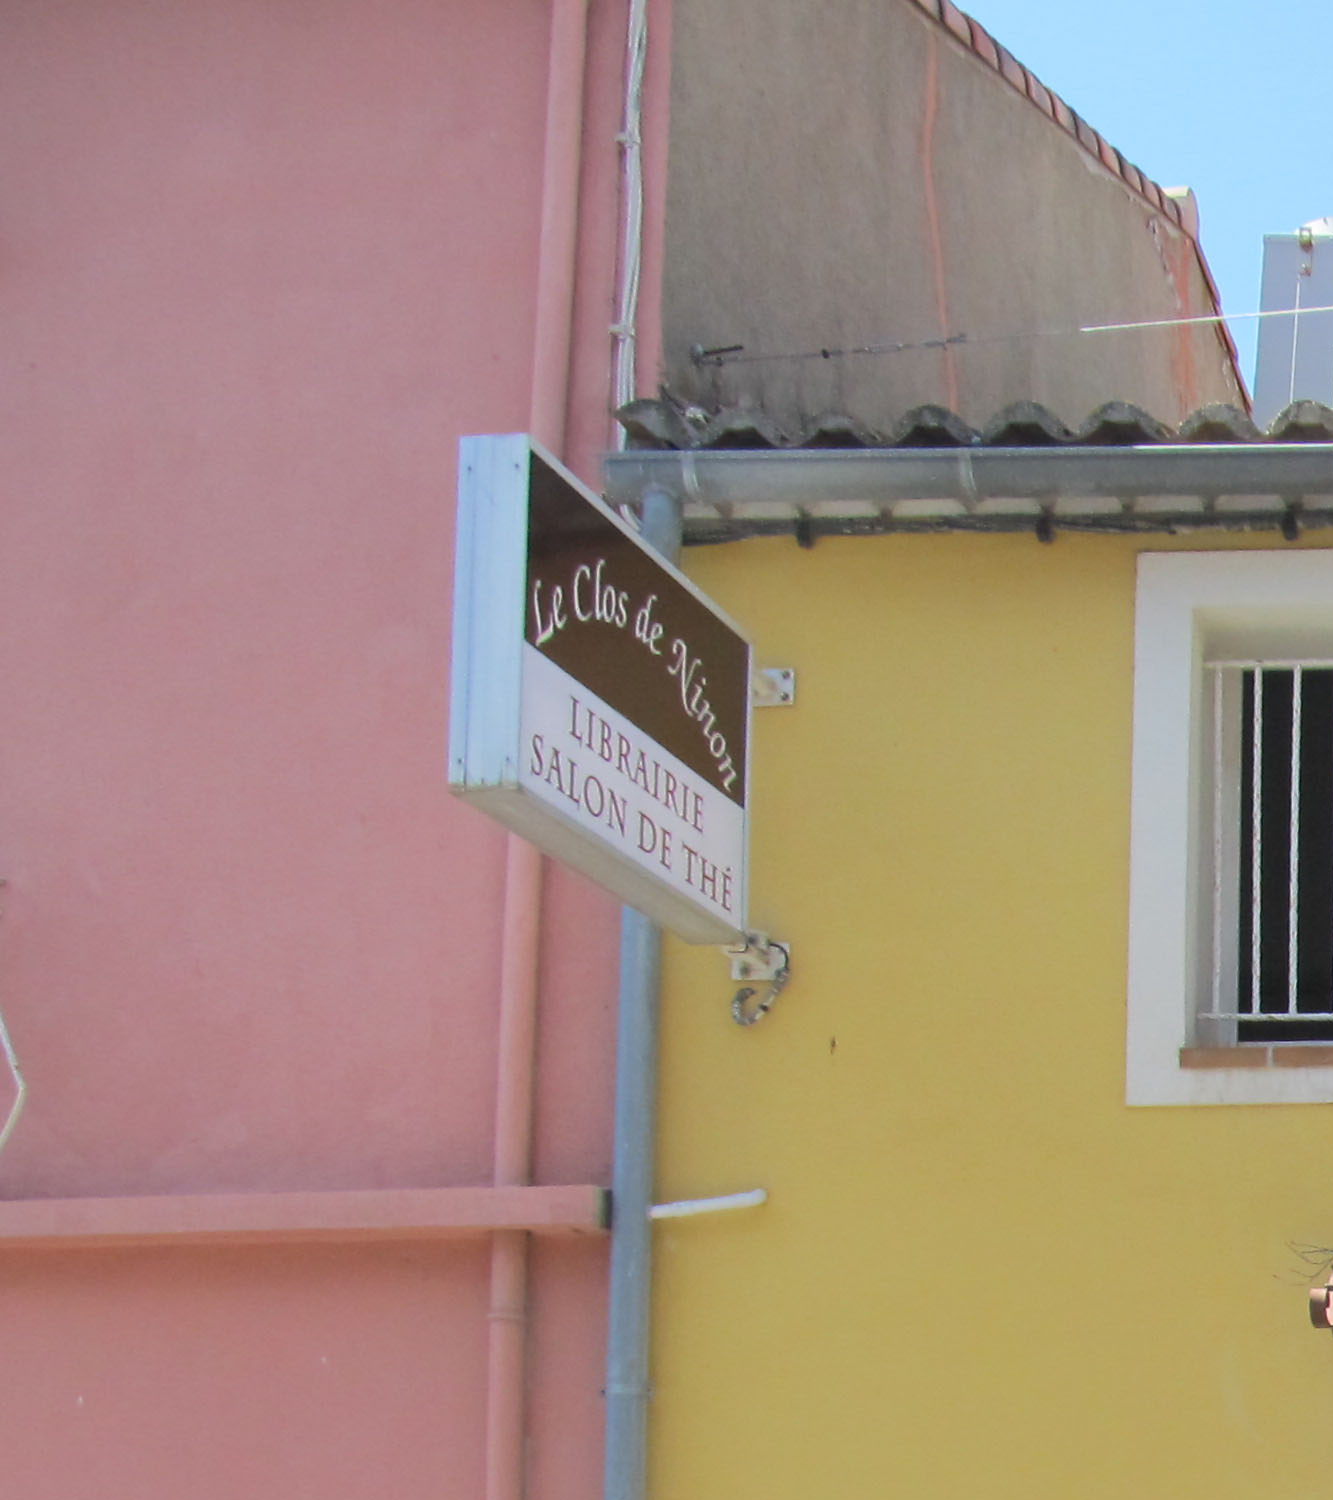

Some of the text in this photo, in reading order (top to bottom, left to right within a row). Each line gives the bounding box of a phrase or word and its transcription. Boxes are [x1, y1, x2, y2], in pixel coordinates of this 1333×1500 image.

[534, 559, 737, 793] Le Clos de Ninon
[568, 694, 704, 834] LIBRAIRIE
[531, 733, 732, 913] SALON DE THÉ
